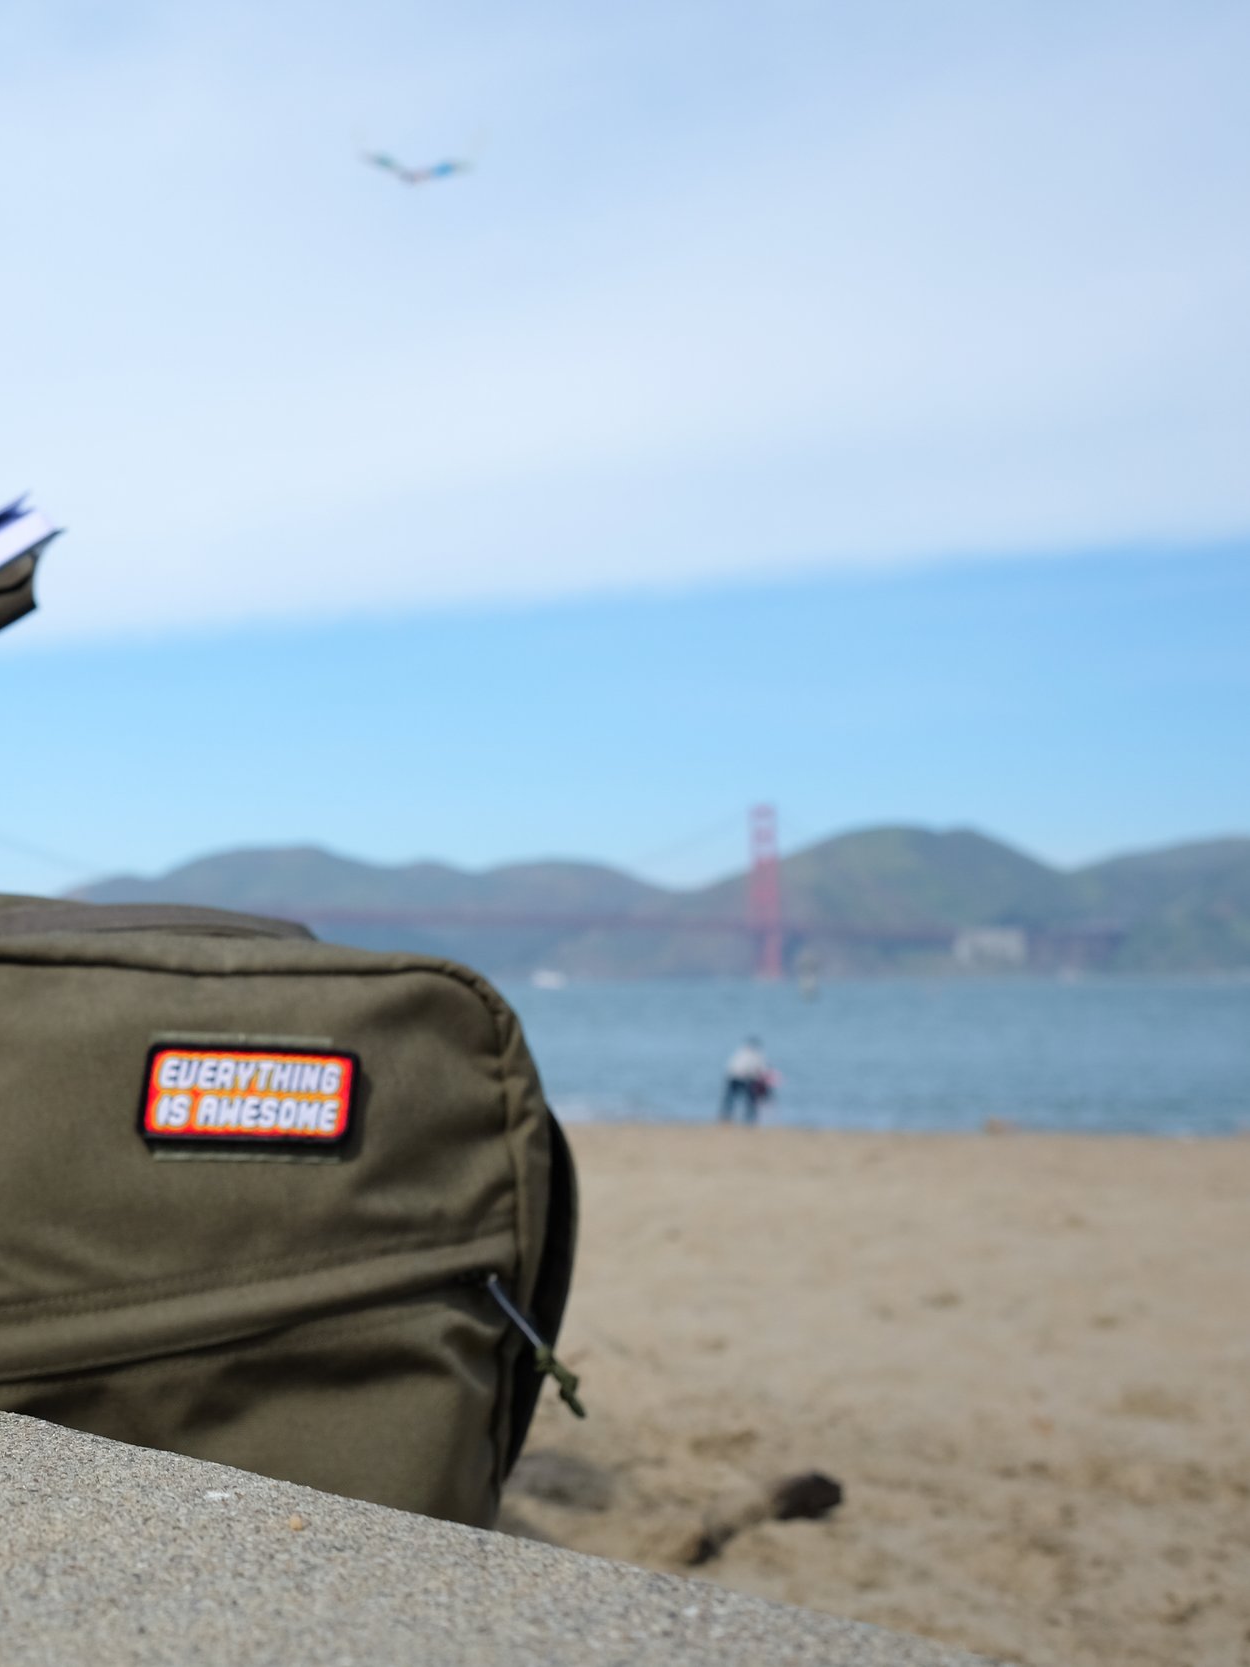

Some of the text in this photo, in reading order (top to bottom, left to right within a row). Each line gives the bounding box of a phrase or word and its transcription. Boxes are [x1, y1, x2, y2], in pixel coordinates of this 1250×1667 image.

[158, 1057, 342, 1095] EVERYTHING
[155, 1094, 339, 1133] IS AWESOME
